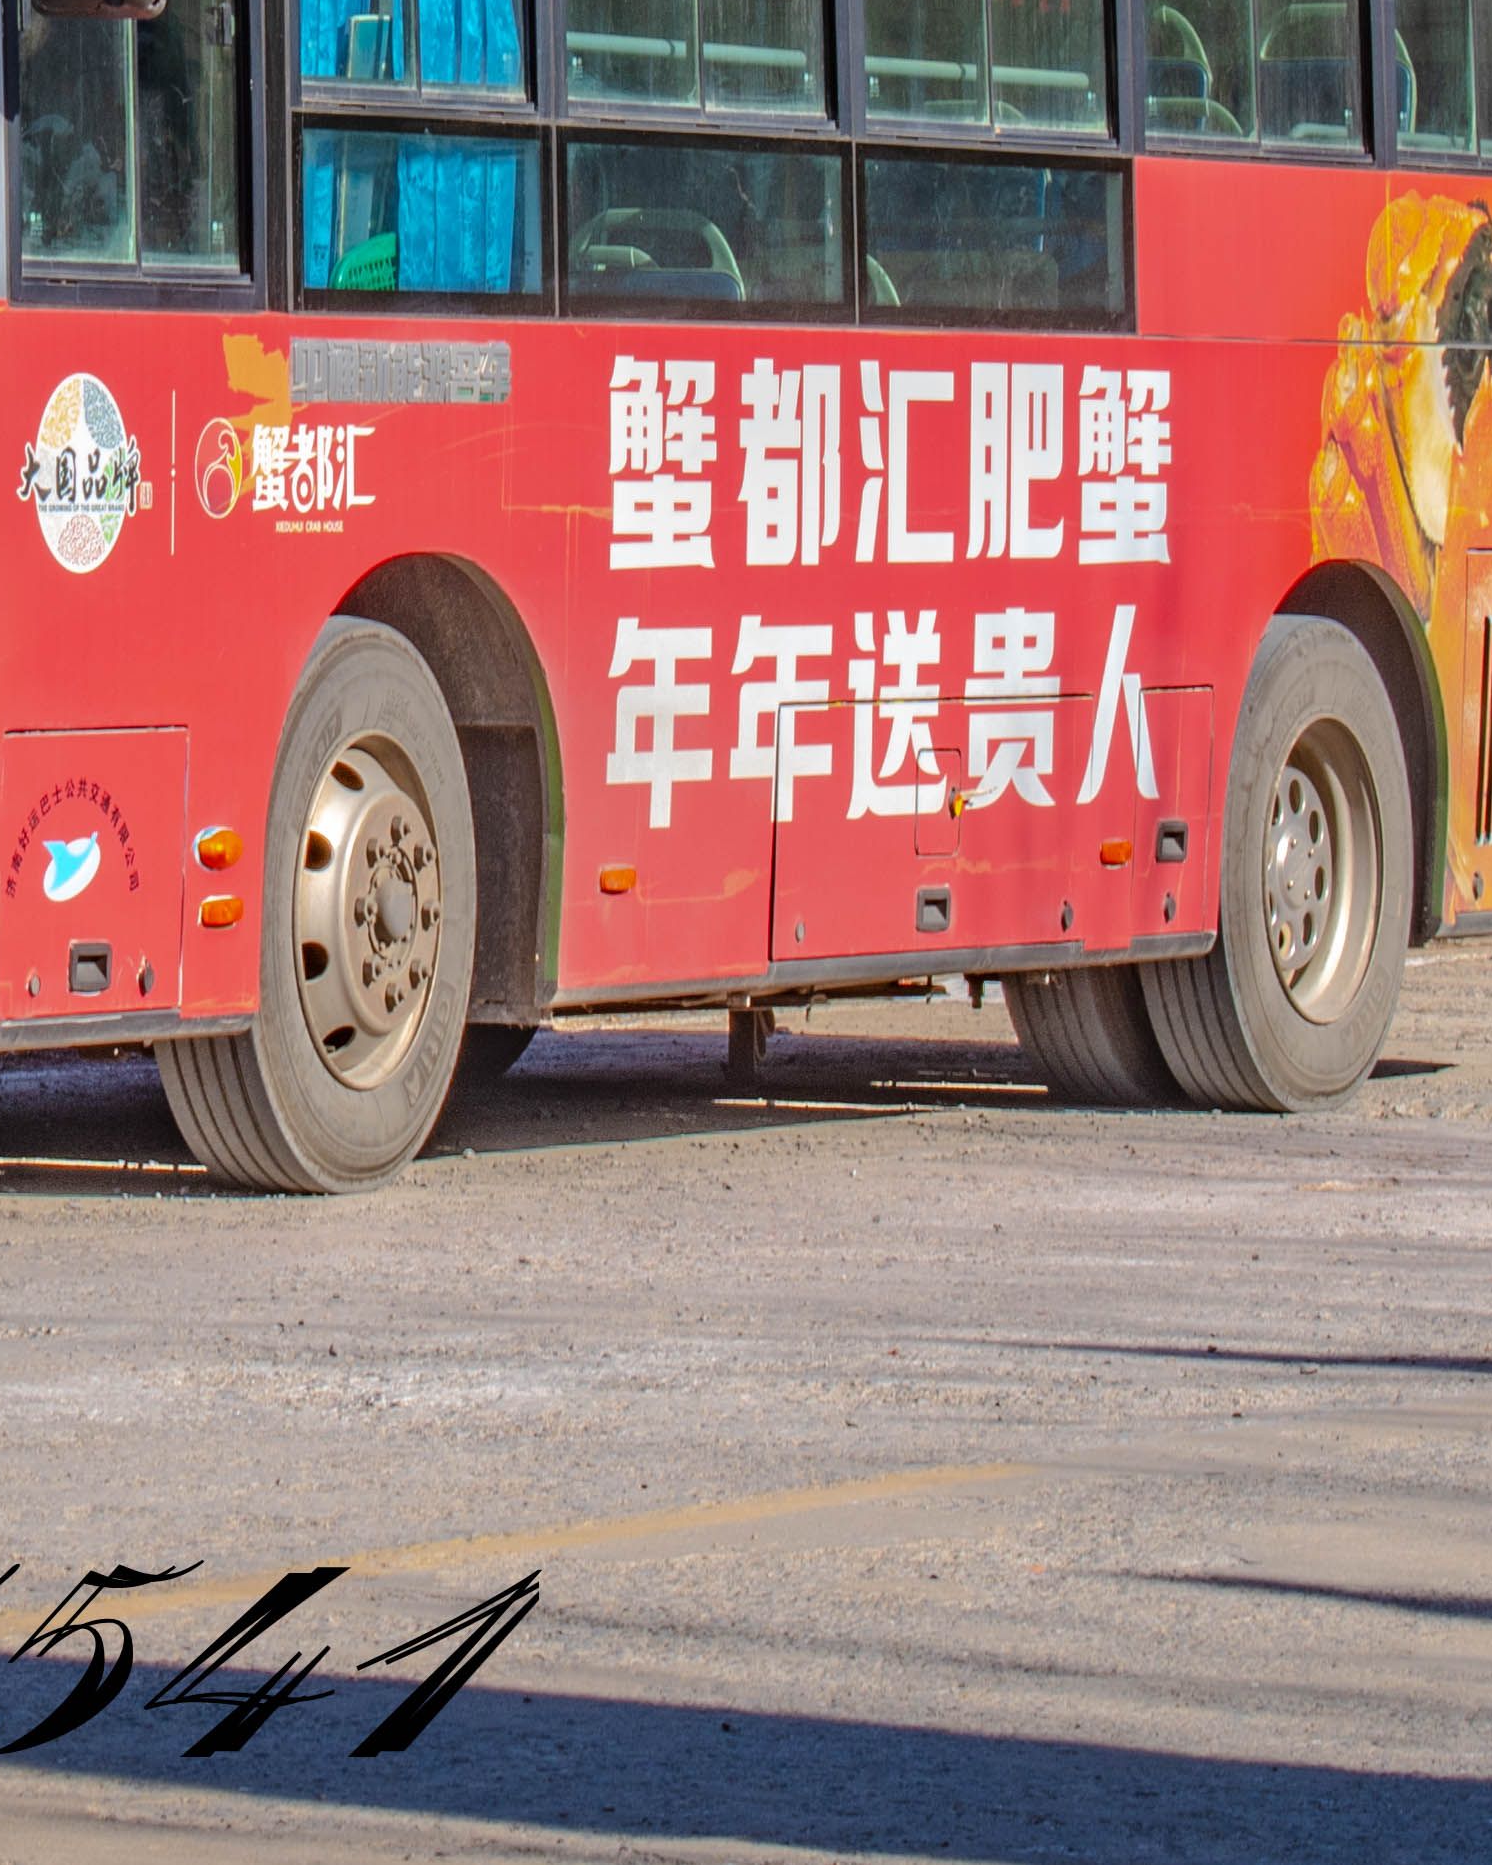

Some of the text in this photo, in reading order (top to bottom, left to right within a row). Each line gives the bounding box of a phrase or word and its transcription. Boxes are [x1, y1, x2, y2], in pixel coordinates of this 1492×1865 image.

[19, 438, 139, 513] 大国品牌
[251, 422, 377, 514] 蟹都汇
[608, 354, 1172, 571] 蟹都汇肥蟹
[605, 603, 1160, 829] 年年送贵人
